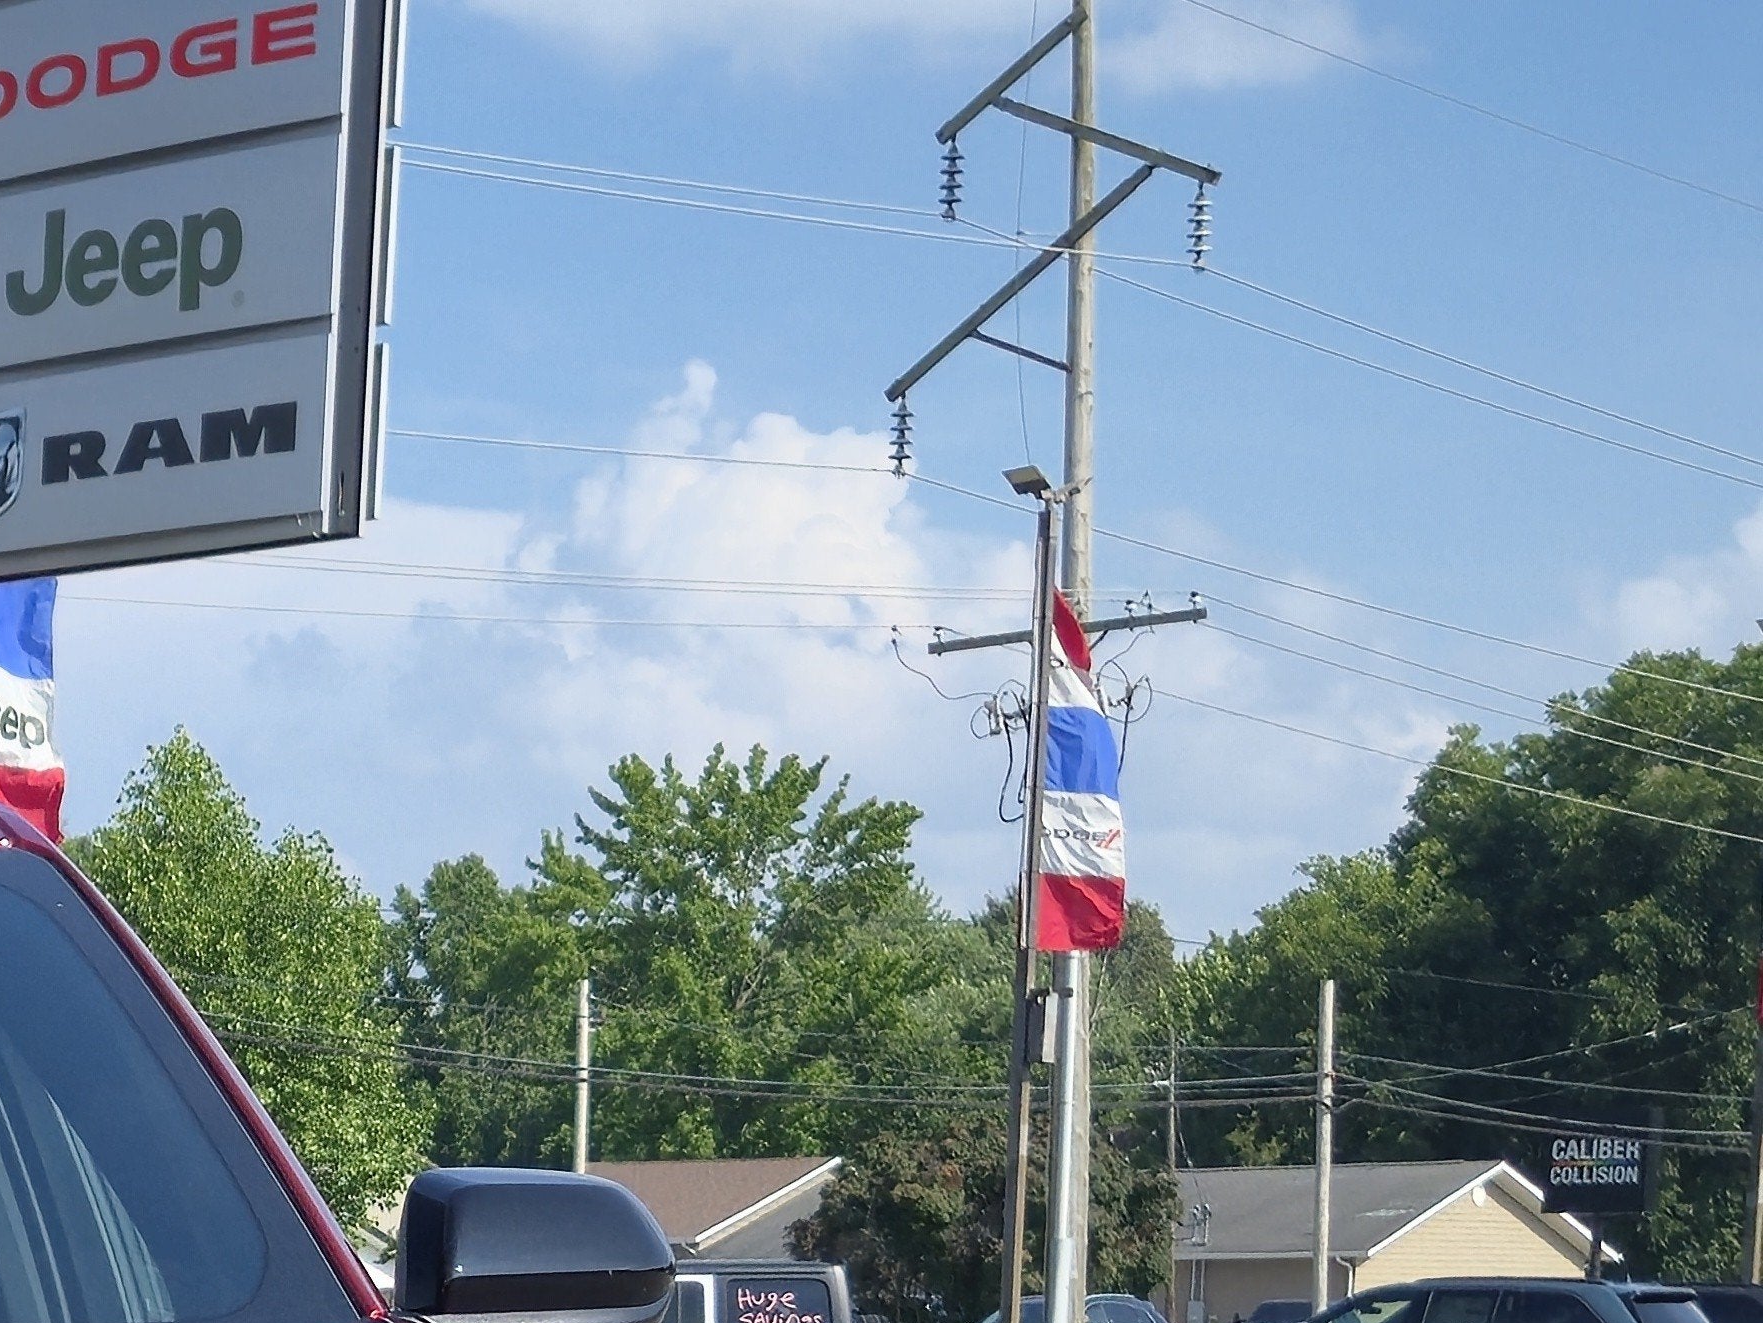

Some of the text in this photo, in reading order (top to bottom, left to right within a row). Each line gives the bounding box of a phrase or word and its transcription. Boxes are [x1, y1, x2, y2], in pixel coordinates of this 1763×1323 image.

[5, 206, 243, 316] Jeep
[40, 400, 298, 485] RAM
[1551, 1138, 1640, 1161] CALIBER
[1549, 1165, 1639, 1185] COLLISION
[737, 1287, 797, 1312] Huge
